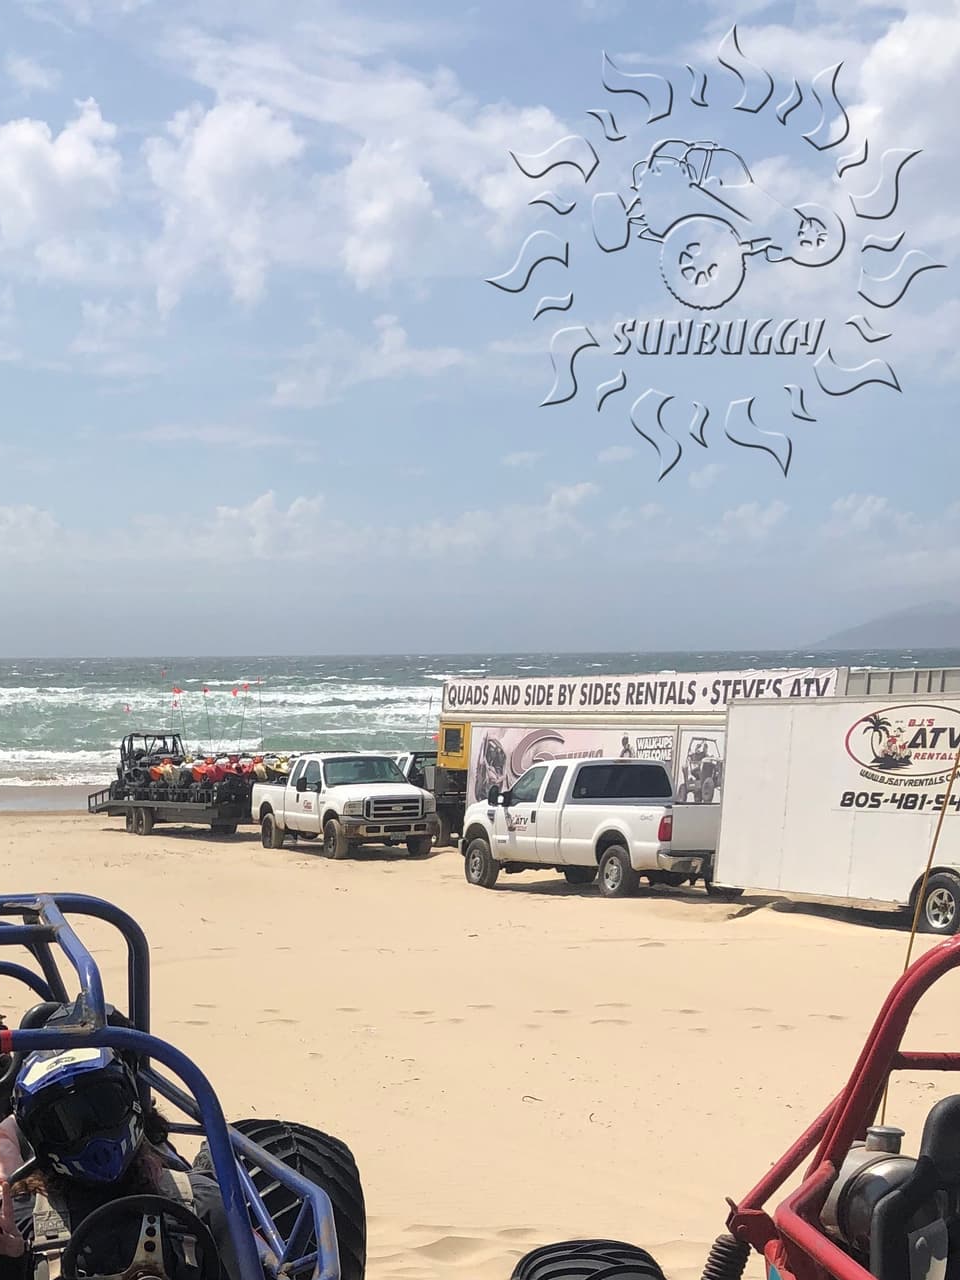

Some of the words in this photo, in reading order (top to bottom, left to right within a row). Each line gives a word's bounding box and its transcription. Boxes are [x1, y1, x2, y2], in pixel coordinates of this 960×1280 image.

[448, 684, 489, 707] QUADS
[492, 684, 520, 706] AND
[524, 684, 554, 706] SIDE
[557, 683, 576, 706] BY
[579, 682, 621, 706] SIDES
[625, 680, 696, 705] RENTALS
[710, 678, 782, 704] STEVE'S
[790, 677, 830, 697] ATV
[637, 735, 673, 749] WALK-UPS
[638, 749, 672, 760] WELCOME
